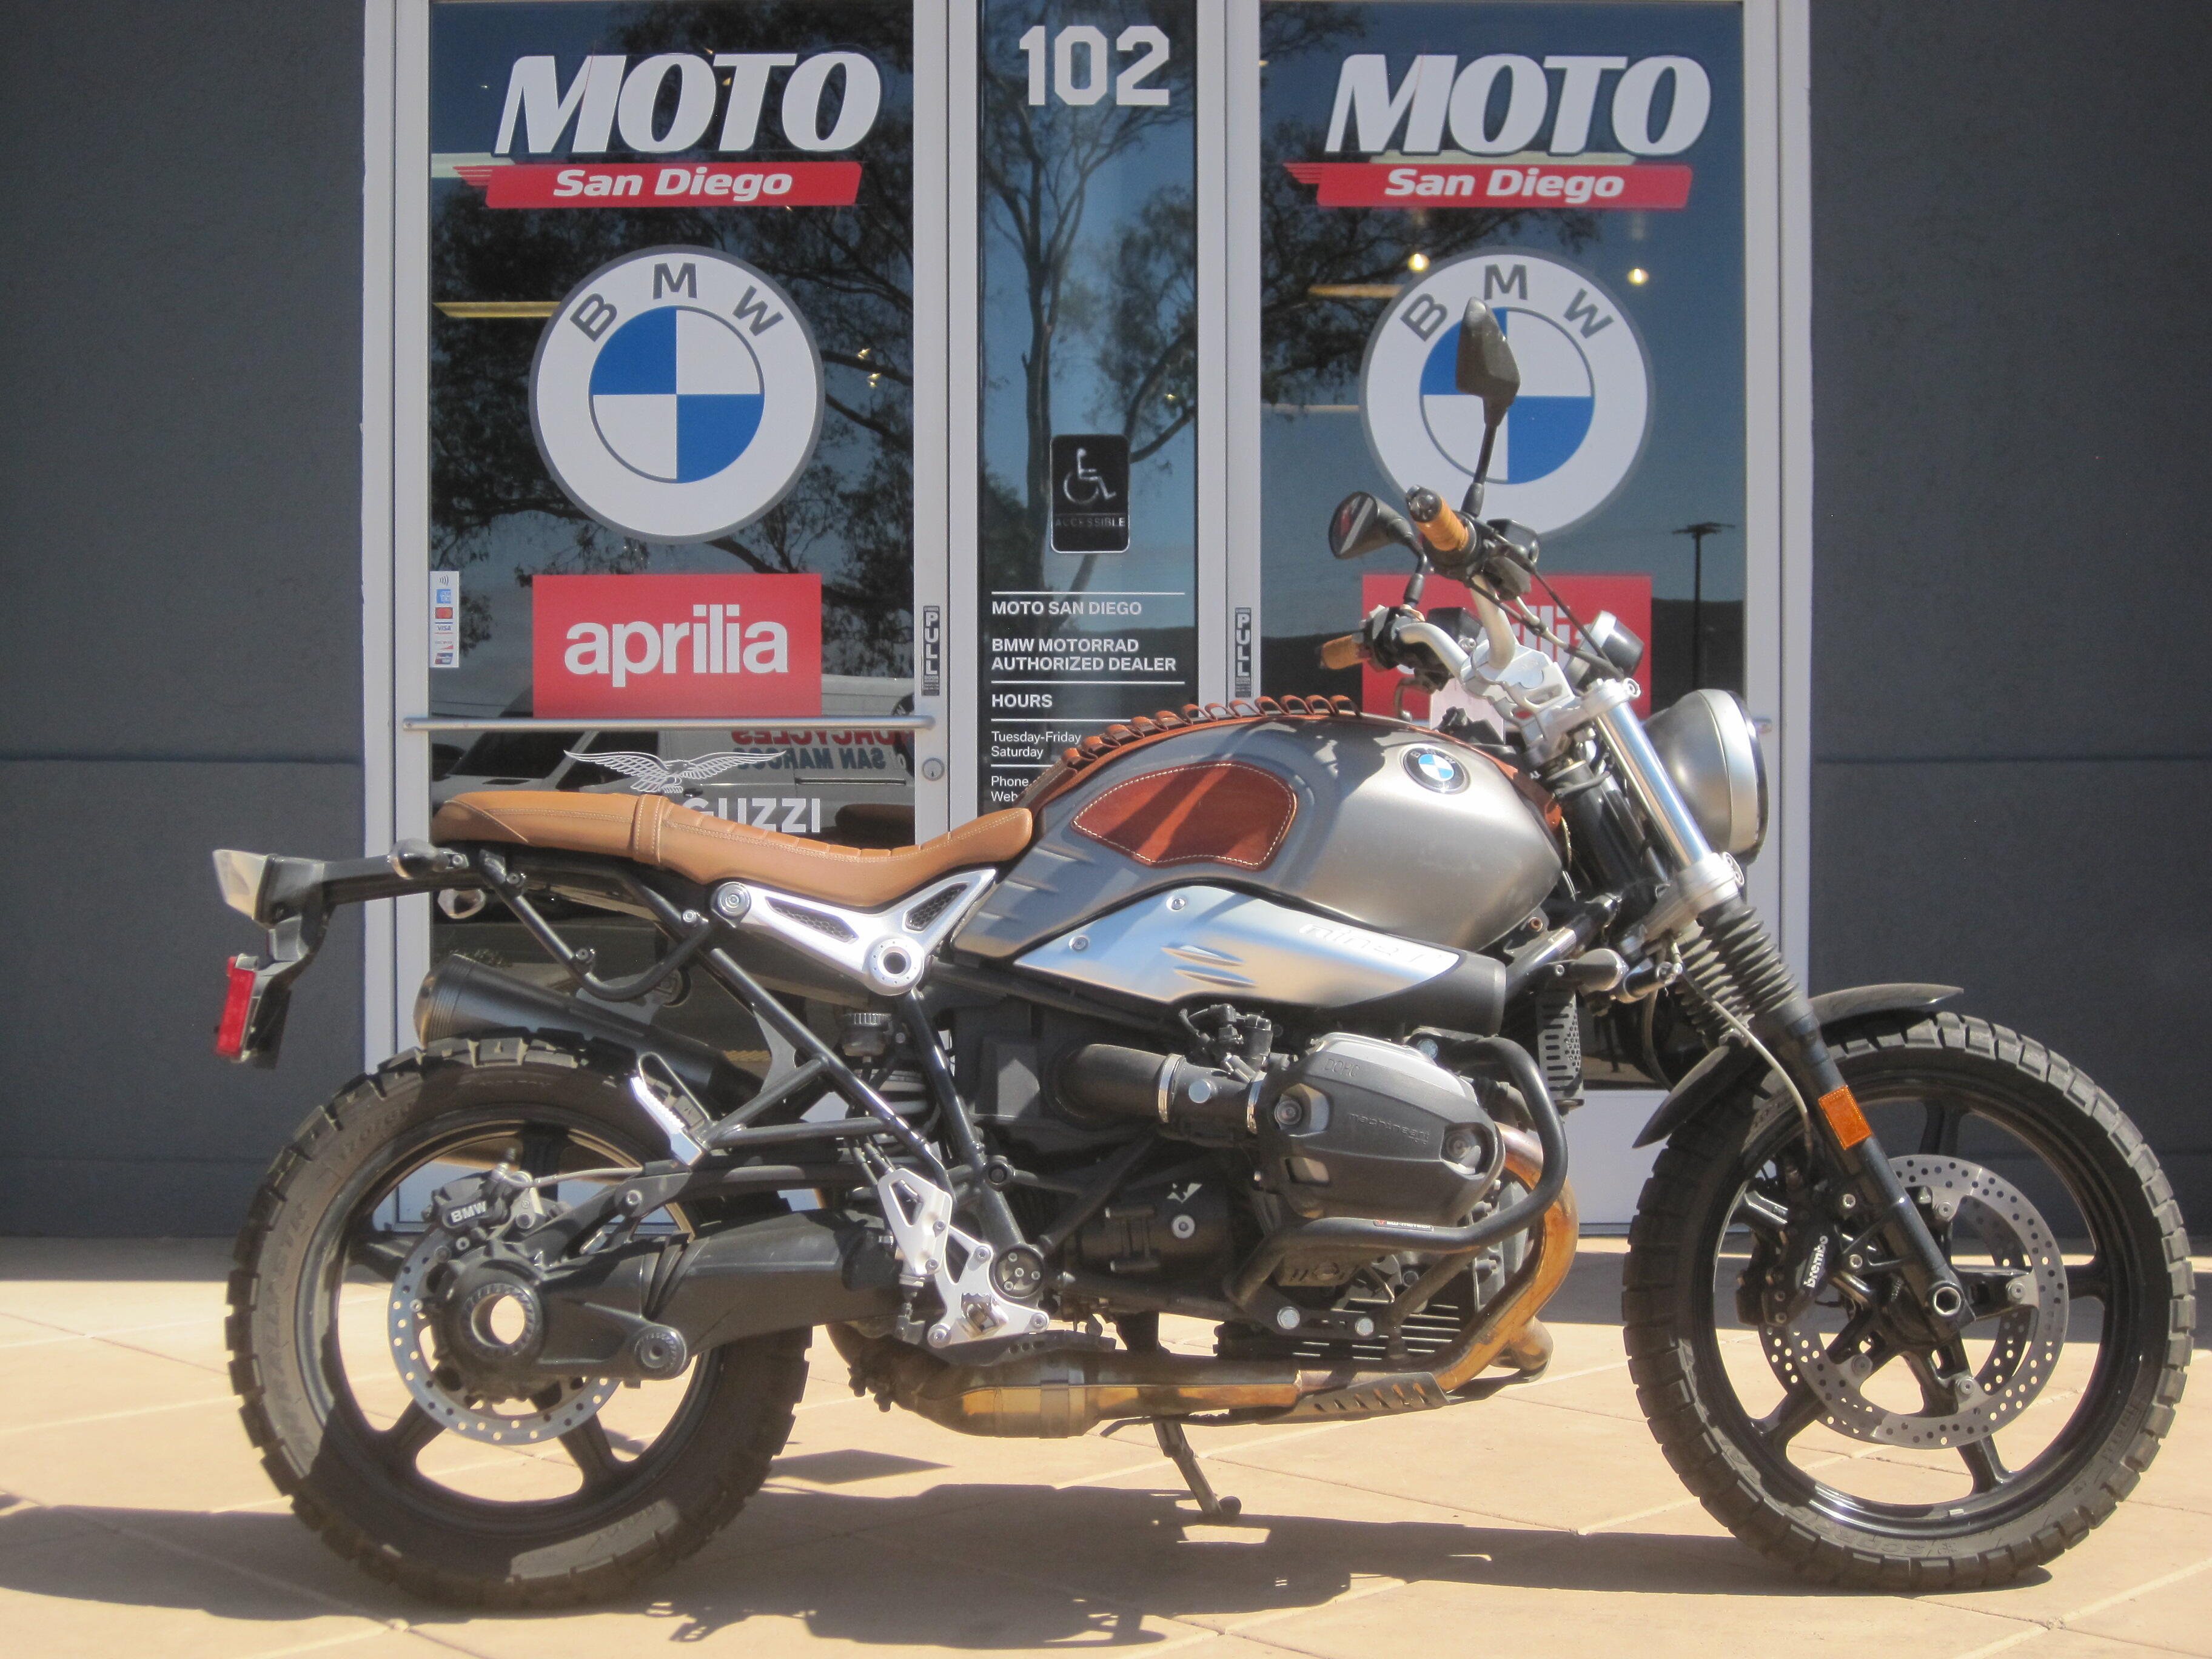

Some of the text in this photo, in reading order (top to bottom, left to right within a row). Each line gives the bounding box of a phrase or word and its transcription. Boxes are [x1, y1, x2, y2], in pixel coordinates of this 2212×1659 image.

[1019, 25, 1170, 105] 102
[495, 52, 882, 154] MOTO
[1325, 53, 1711, 155] MOTO
[553, 166, 793, 201] San Diego
[1384, 166, 1624, 203] San Diego
[570, 263, 783, 342] BMW
[1400, 264, 1614, 341] BMW
[991, 601, 1142, 615] MOTO SAN DIEGO
[565, 604, 788, 688] aprilia
[924, 611, 939, 675] PULL
[991, 638, 1139, 652] BMW MOTORRAD
[1236, 613, 1251, 677] PULL
[991, 657, 1176, 671] AUTHORIZED DEALER
[991, 694, 1053, 708] HOURS
[991, 731, 1082, 745] Tuesday-Friday
[991, 746, 1044, 759] Saturday
[991, 776, 1029, 787] Phone
[450, 1200, 486, 1223] BMW
[1803, 1235, 1829, 1289] brembo
